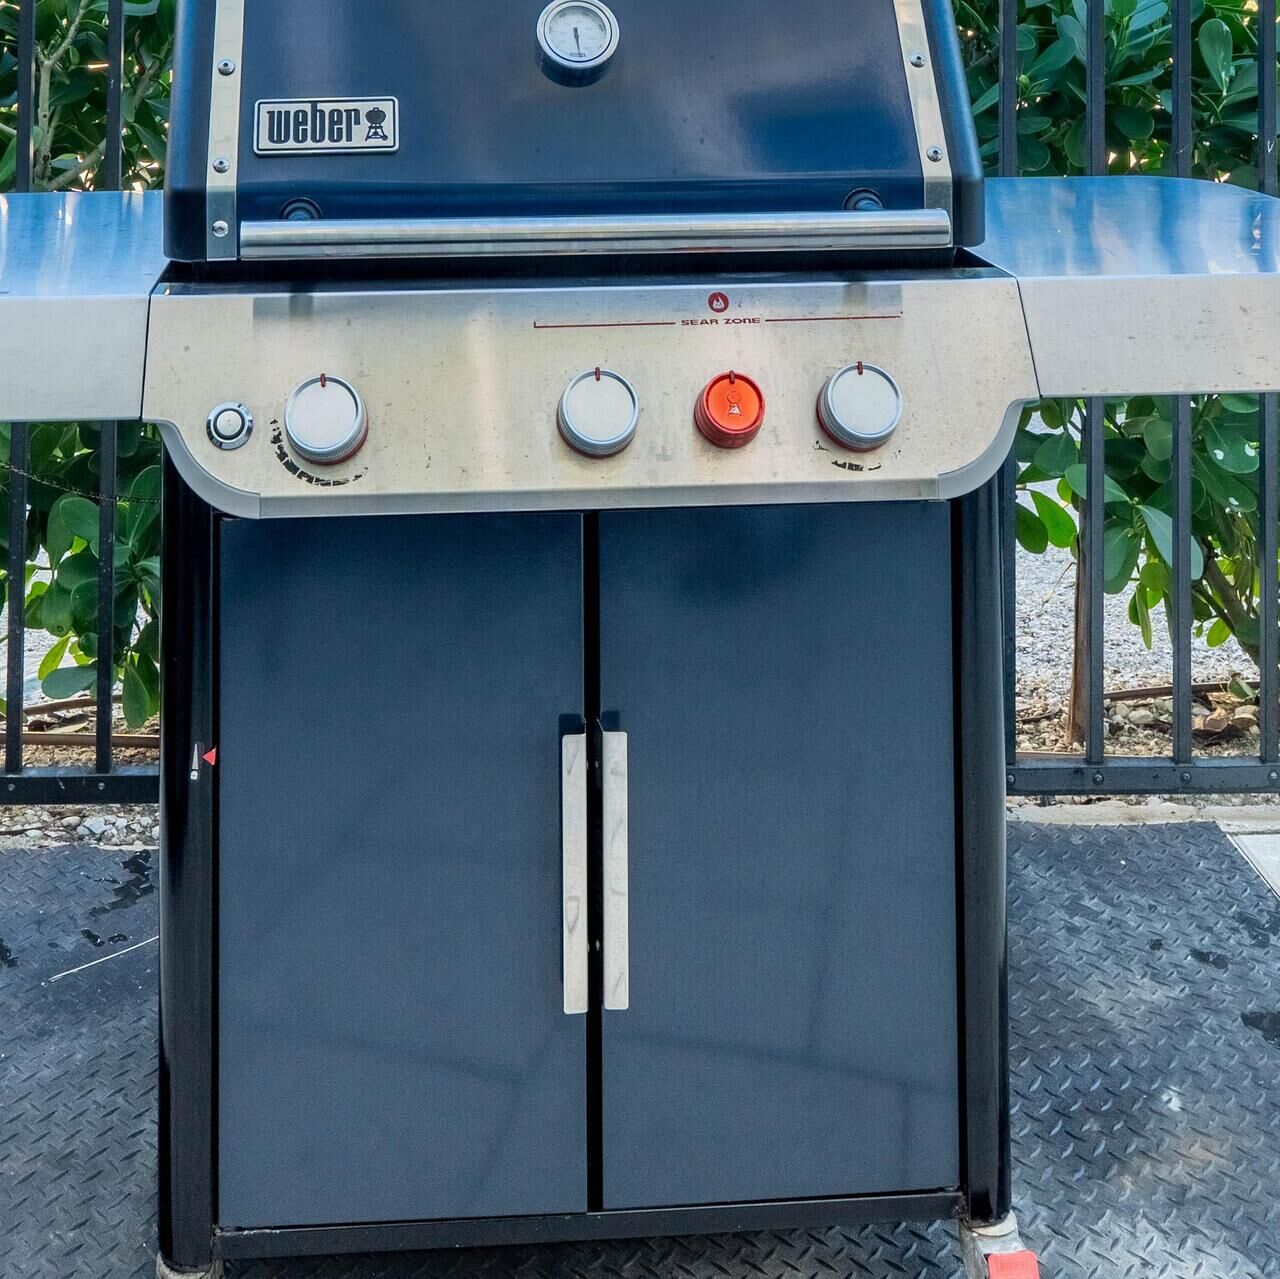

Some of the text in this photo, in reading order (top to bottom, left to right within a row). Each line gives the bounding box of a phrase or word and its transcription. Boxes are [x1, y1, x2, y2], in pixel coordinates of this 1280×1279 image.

[267, 102, 361, 144] weber
[681, 317, 761, 326] SEAR ZONE
